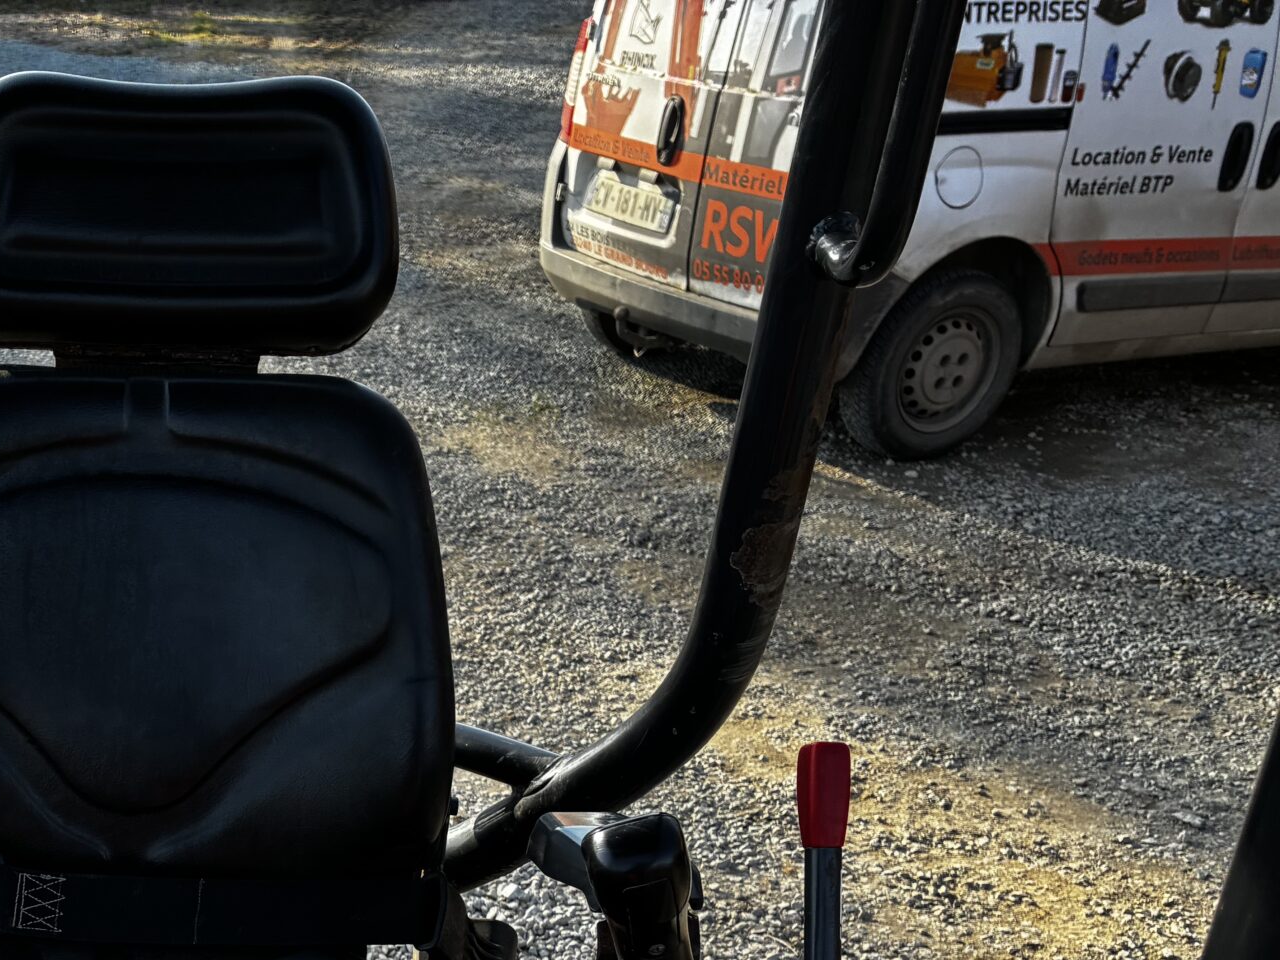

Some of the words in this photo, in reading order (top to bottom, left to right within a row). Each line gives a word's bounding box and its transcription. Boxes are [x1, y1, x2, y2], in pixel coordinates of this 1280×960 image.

[1071, 147, 1146, 167] Location
[1150, 145, 1164, 164] &
[1168, 147, 1214, 164] Vente
[704, 161, 783, 195] Matériel
[1064, 175, 1136, 197] Matériel
[1139, 176, 1175, 194] BTP
[693, 259, 709, 281] 05
[713, 264, 729, 286] 55
